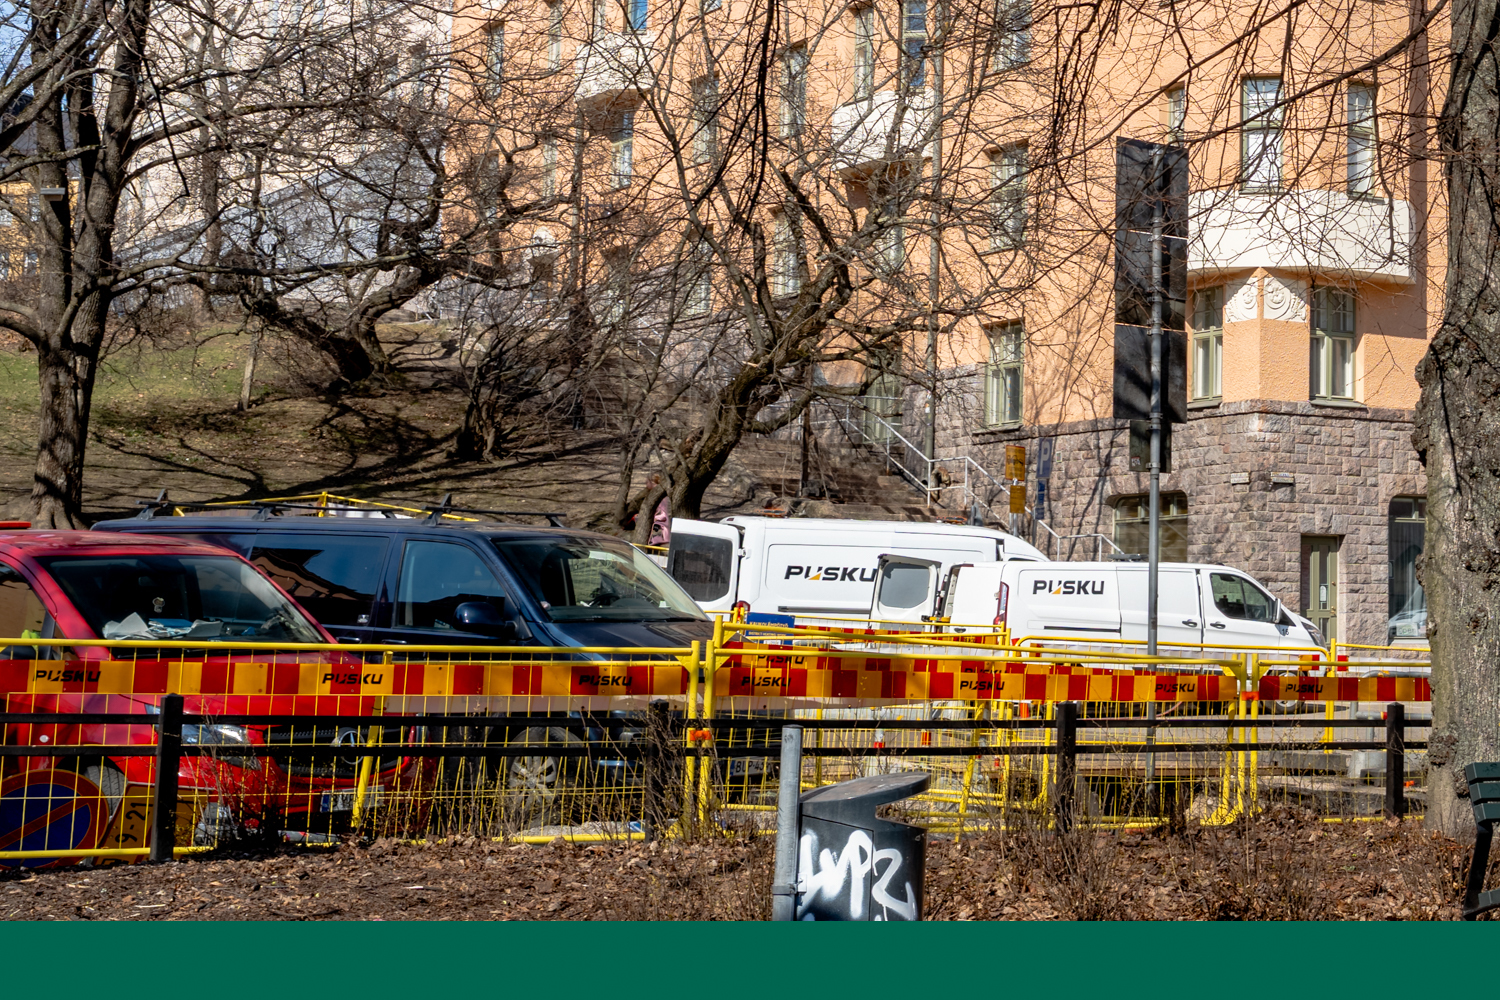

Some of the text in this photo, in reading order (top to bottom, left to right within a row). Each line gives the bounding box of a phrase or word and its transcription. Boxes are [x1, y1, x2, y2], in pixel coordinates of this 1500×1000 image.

[784, 565, 877, 582] PUSKU
[1032, 580, 1104, 595] PUSKU
[34, 670, 101, 682] PUSKU
[322, 673, 383, 685] PUSKU
[578, 675, 632, 686] PUSKU
[741, 676, 791, 687] PUSKU
[960, 681, 1005, 690] PUSKU
[1155, 683, 1195, 693] PUSKU
[1285, 683, 1323, 693] PUSKU
